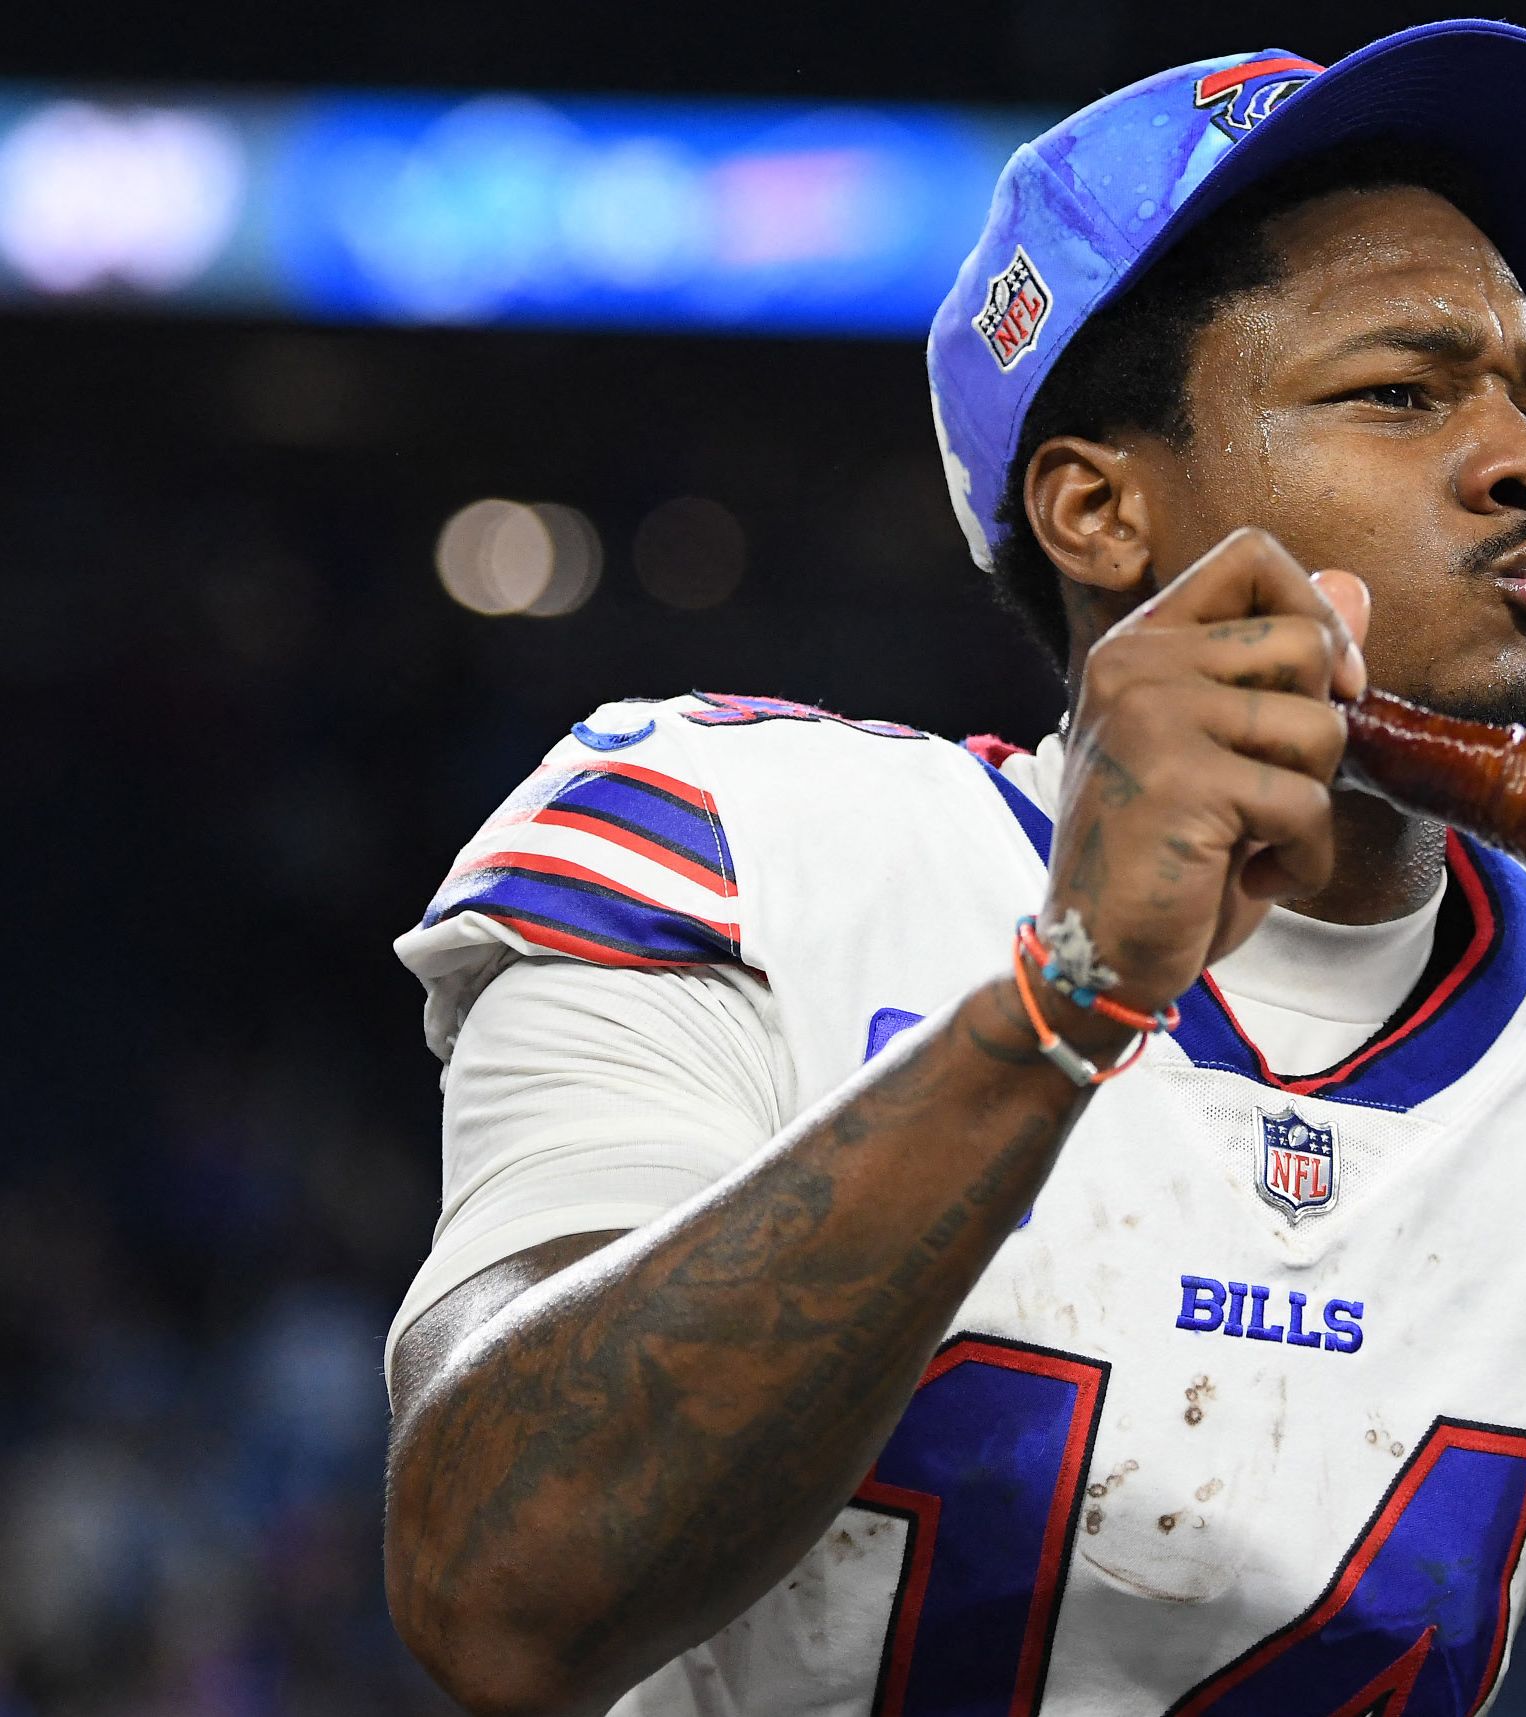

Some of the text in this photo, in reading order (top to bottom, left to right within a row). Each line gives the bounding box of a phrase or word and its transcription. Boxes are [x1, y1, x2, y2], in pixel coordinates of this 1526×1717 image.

[994, 290, 1040, 358] NFL
[1270, 1149, 1327, 1202] NFL
[1175, 1274, 1365, 1355] BILLS
